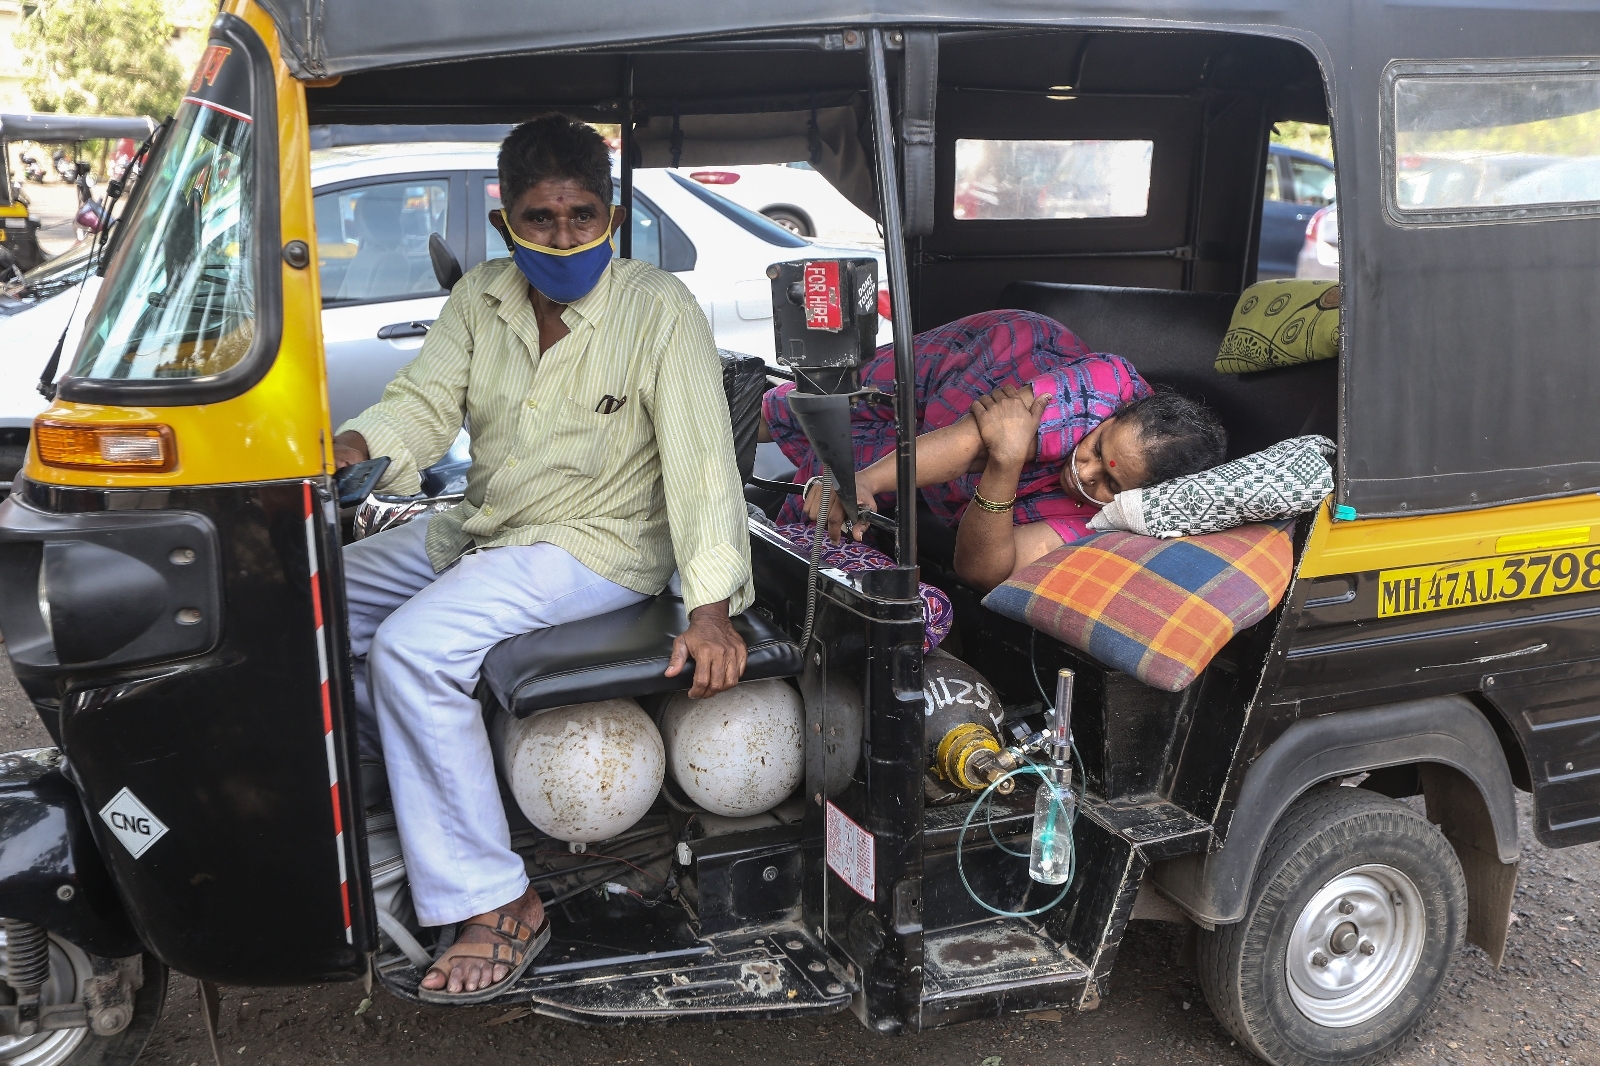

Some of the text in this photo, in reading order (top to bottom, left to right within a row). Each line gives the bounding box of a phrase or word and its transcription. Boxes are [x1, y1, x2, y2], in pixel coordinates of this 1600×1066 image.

[807, 267, 829, 324] FOR HIRE
[858, 282, 876, 309] TOUCH
[865, 296, 874, 312] ME
[110, 811, 151, 836] CNG
